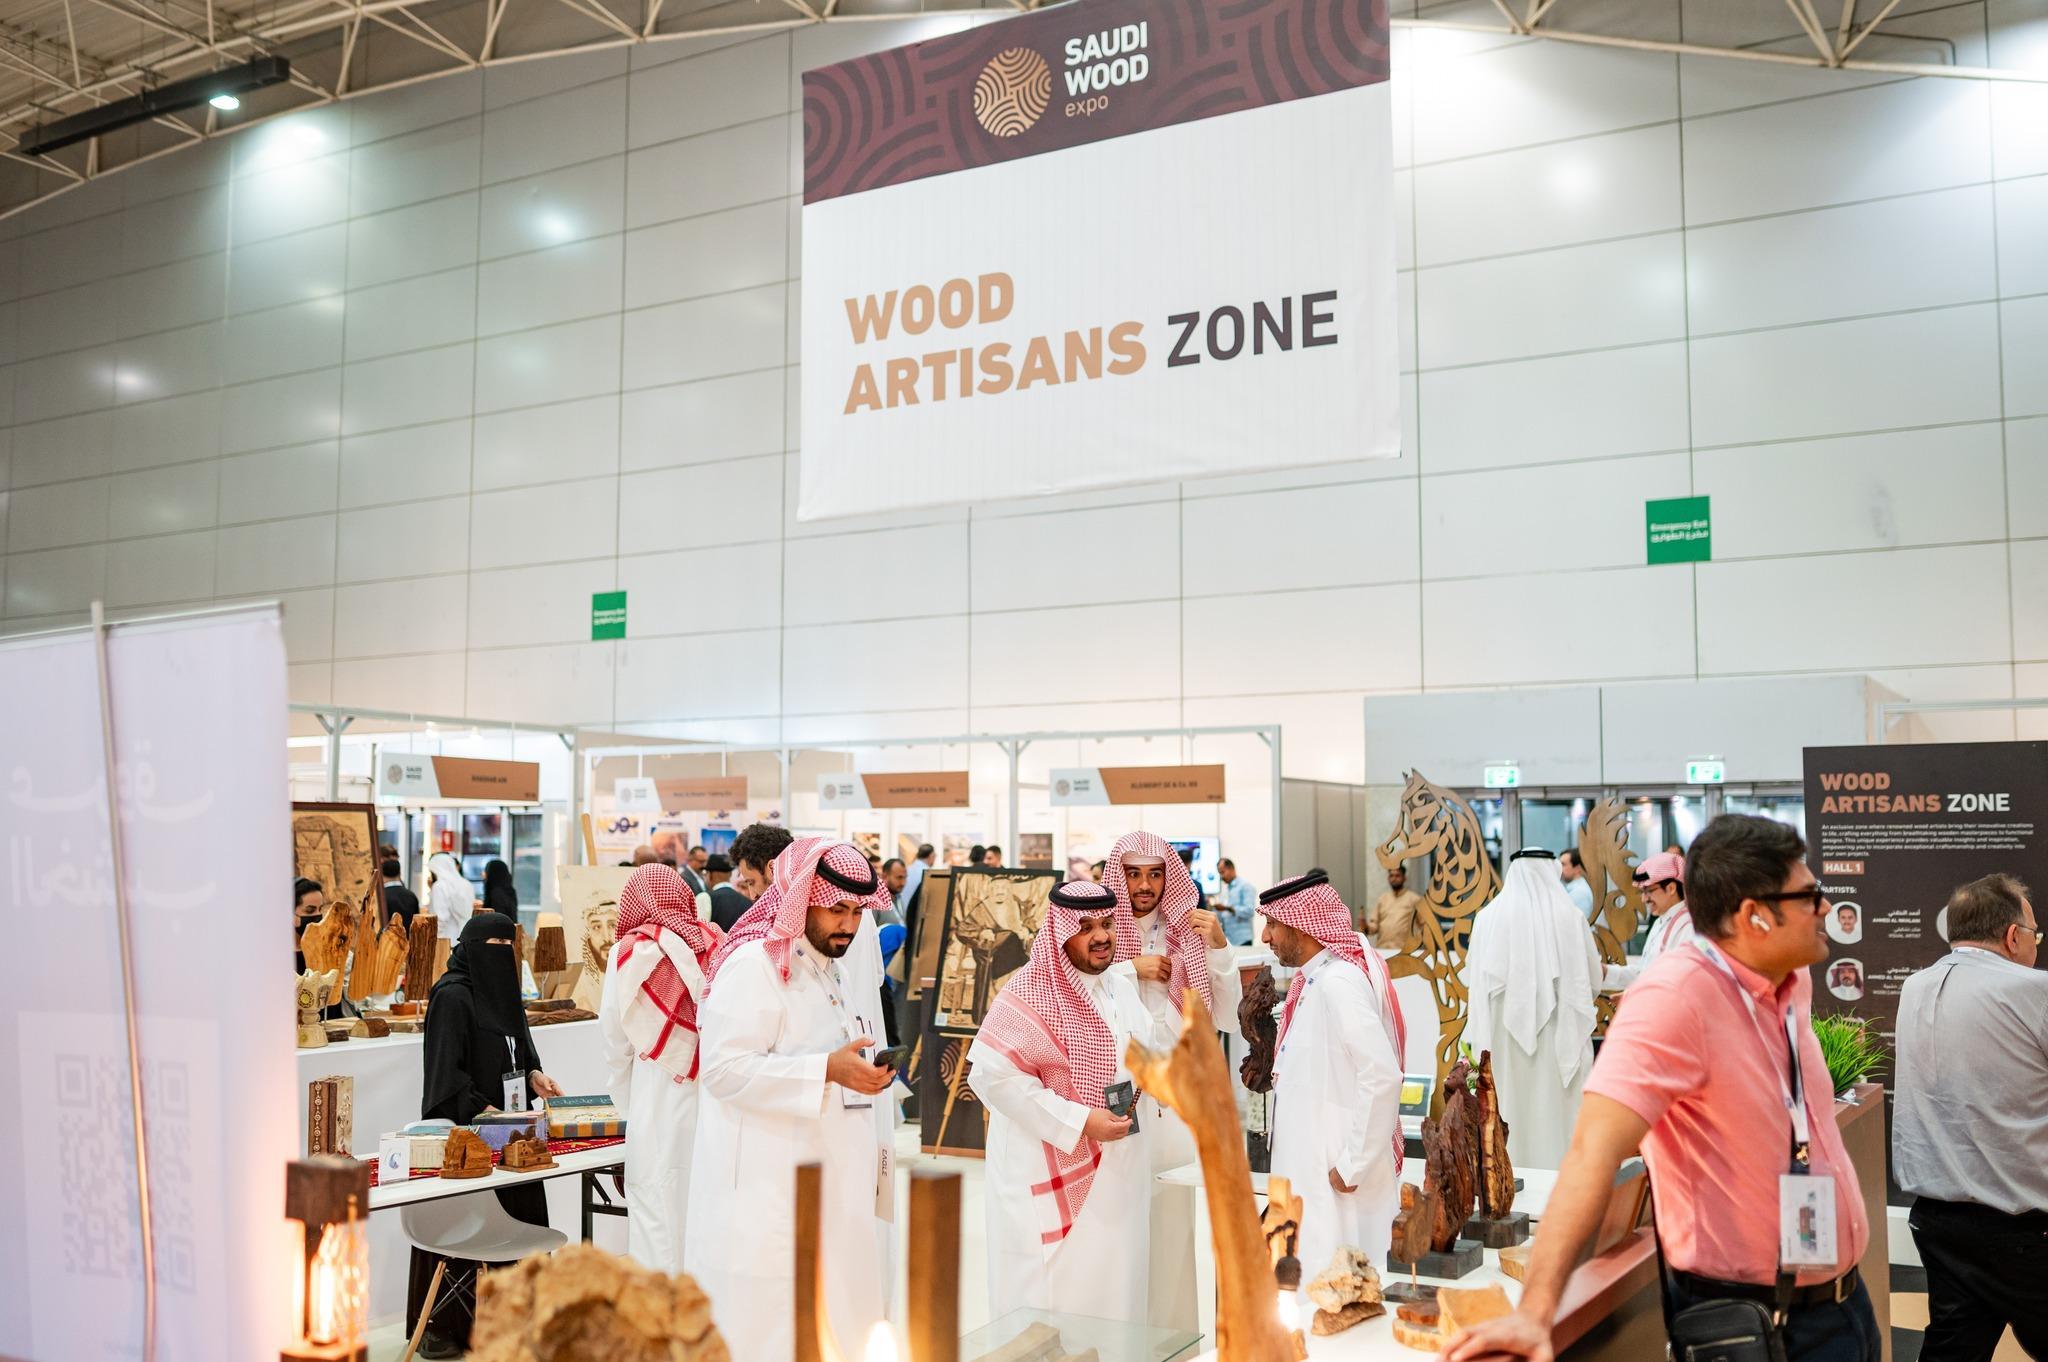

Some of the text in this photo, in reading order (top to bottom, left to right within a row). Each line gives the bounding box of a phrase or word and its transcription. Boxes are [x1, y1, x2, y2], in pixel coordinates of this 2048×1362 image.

[1064, 21, 1148, 66] SAUDI
[1064, 54, 1149, 96] WOOD
[1064, 94, 1109, 118] expo
[843, 272, 1014, 344] WOOD
[843, 290, 1338, 415] ARTISANS ZONE
[1820, 772, 1891, 791] WOOD
[1820, 792, 2011, 814] ARTISANS ZONE
[1825, 863, 1861, 872] HALL 1
